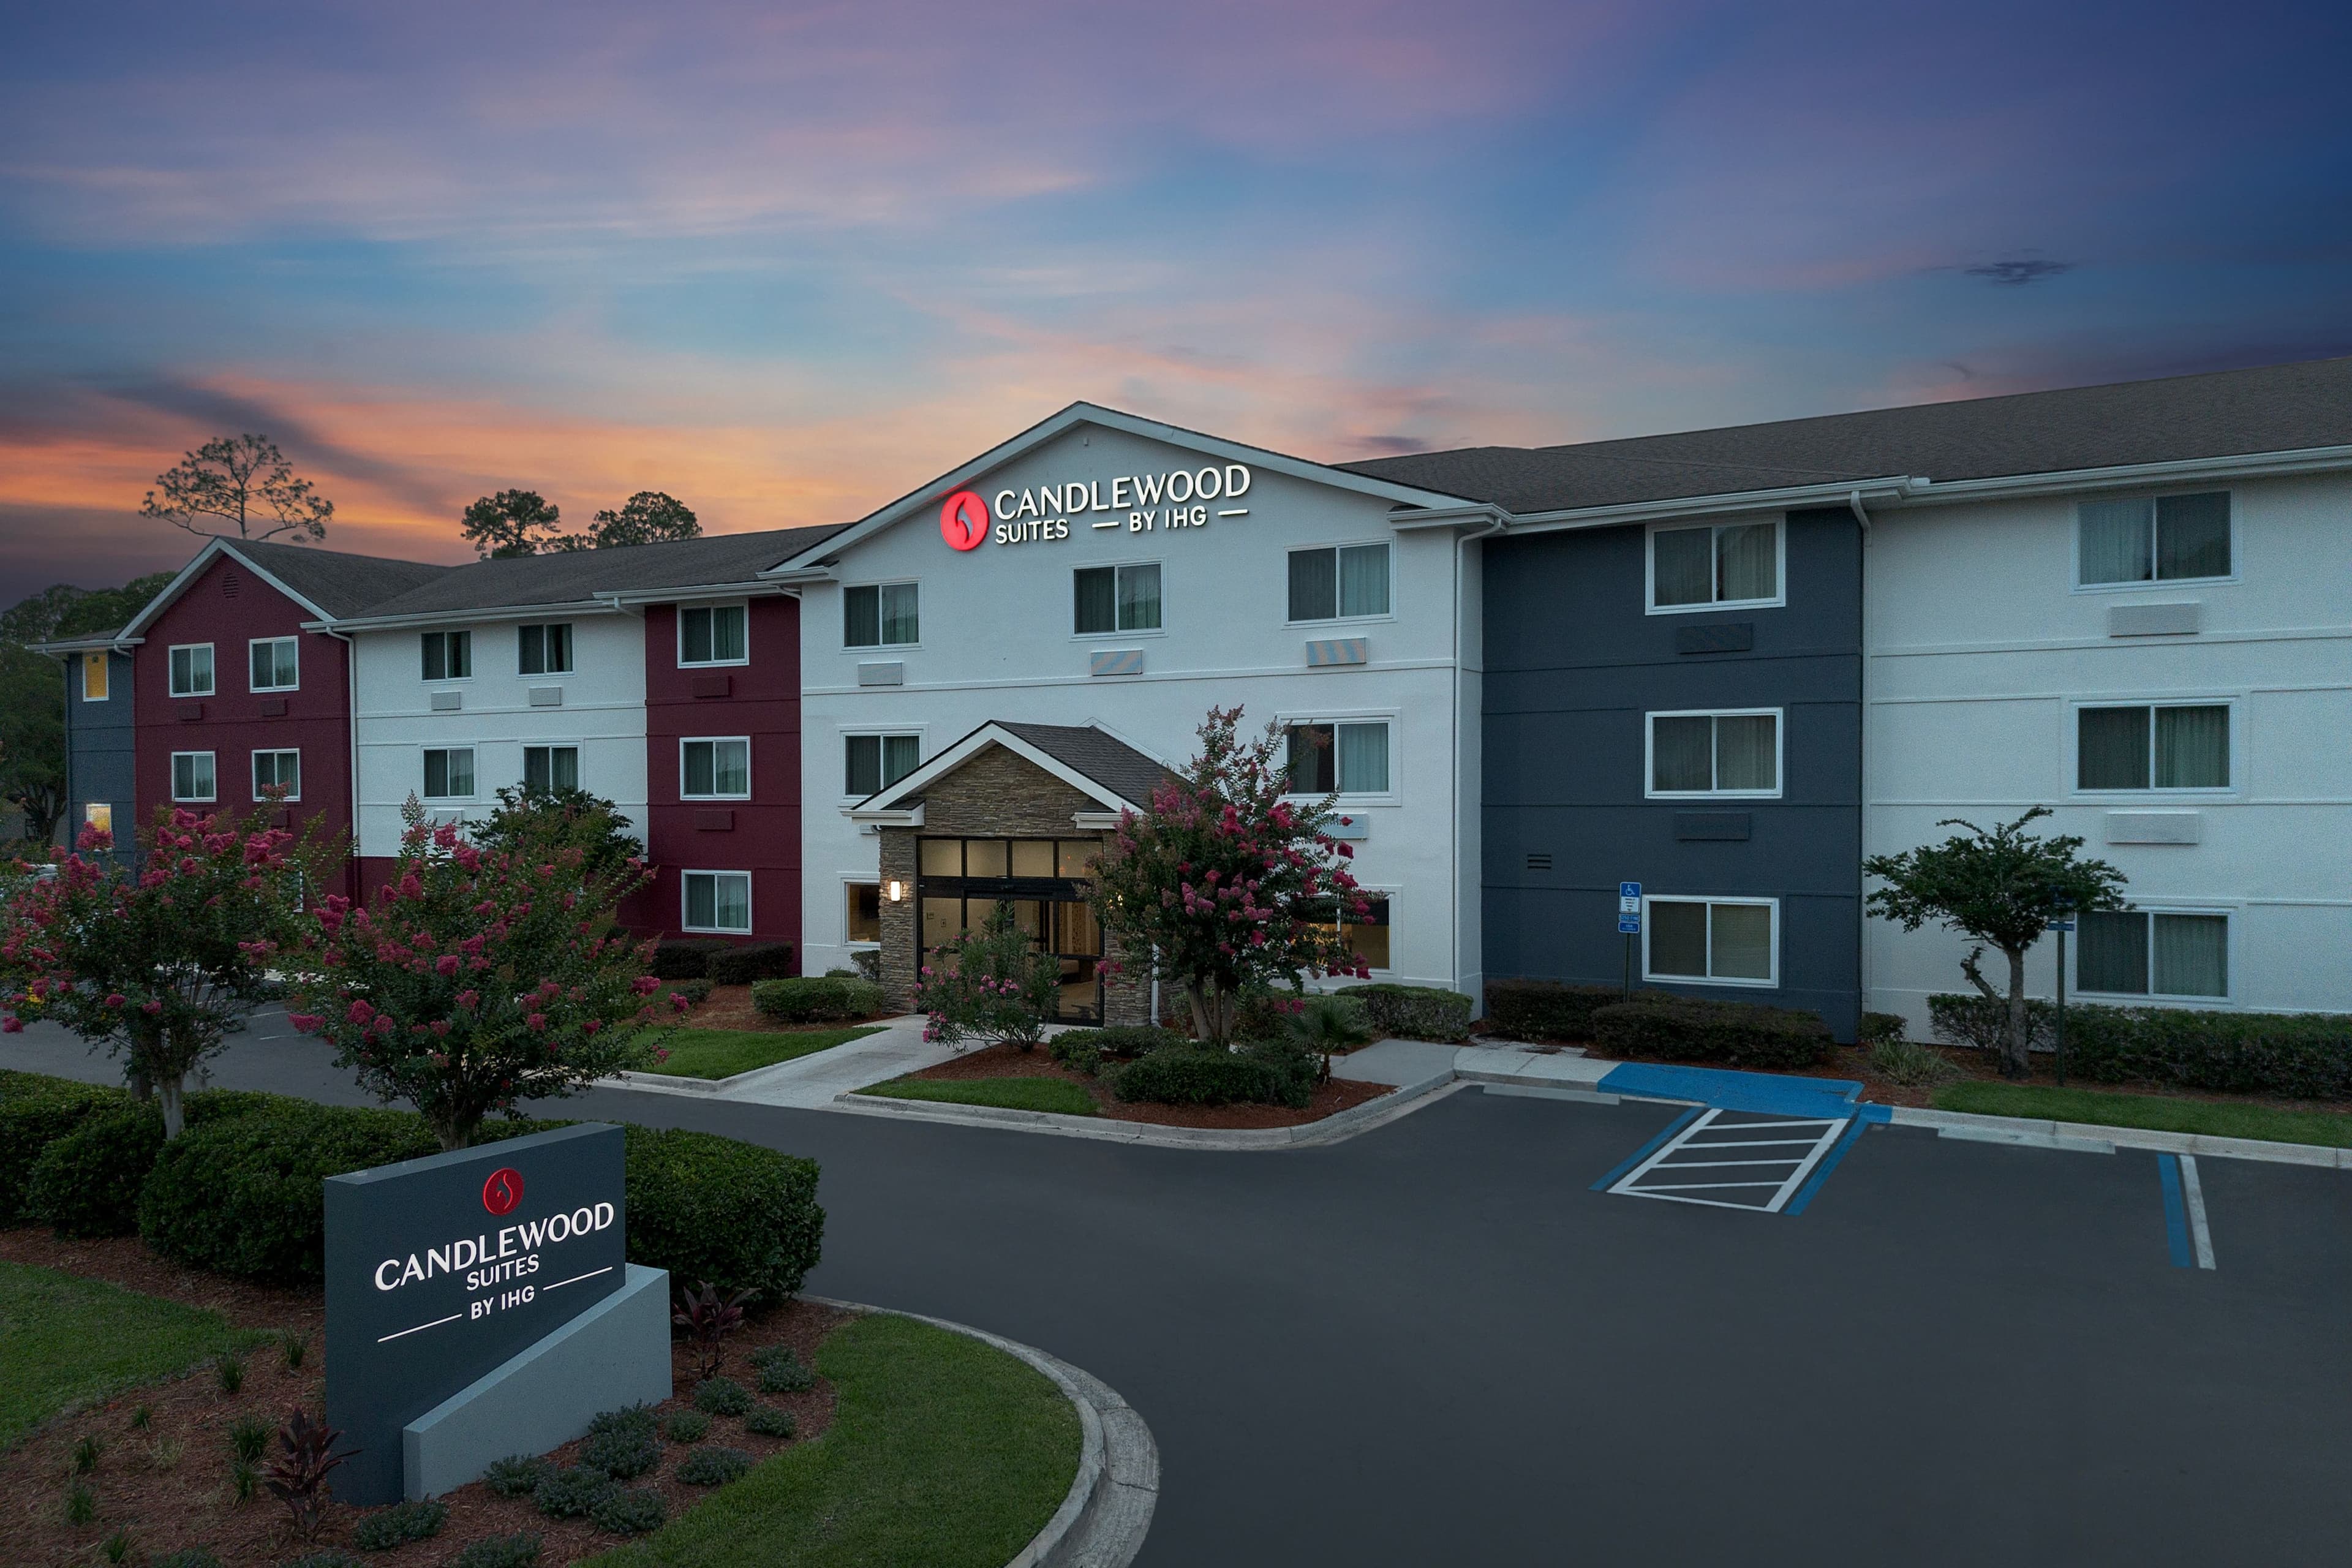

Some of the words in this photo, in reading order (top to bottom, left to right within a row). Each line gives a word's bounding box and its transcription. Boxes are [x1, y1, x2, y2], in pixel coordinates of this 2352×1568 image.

[995, 465, 1250, 520] CANDLEWOOD
[995, 518, 1068, 544] SUITES
[1129, 510, 1156, 532] BY
[1165, 505, 1206, 528] IHG
[375, 1202, 614, 1291] CANDLEWOOD
[467, 1254, 539, 1291] SUITES
[471, 1297, 494, 1320] BY
[502, 1285, 535, 1310] IHG
